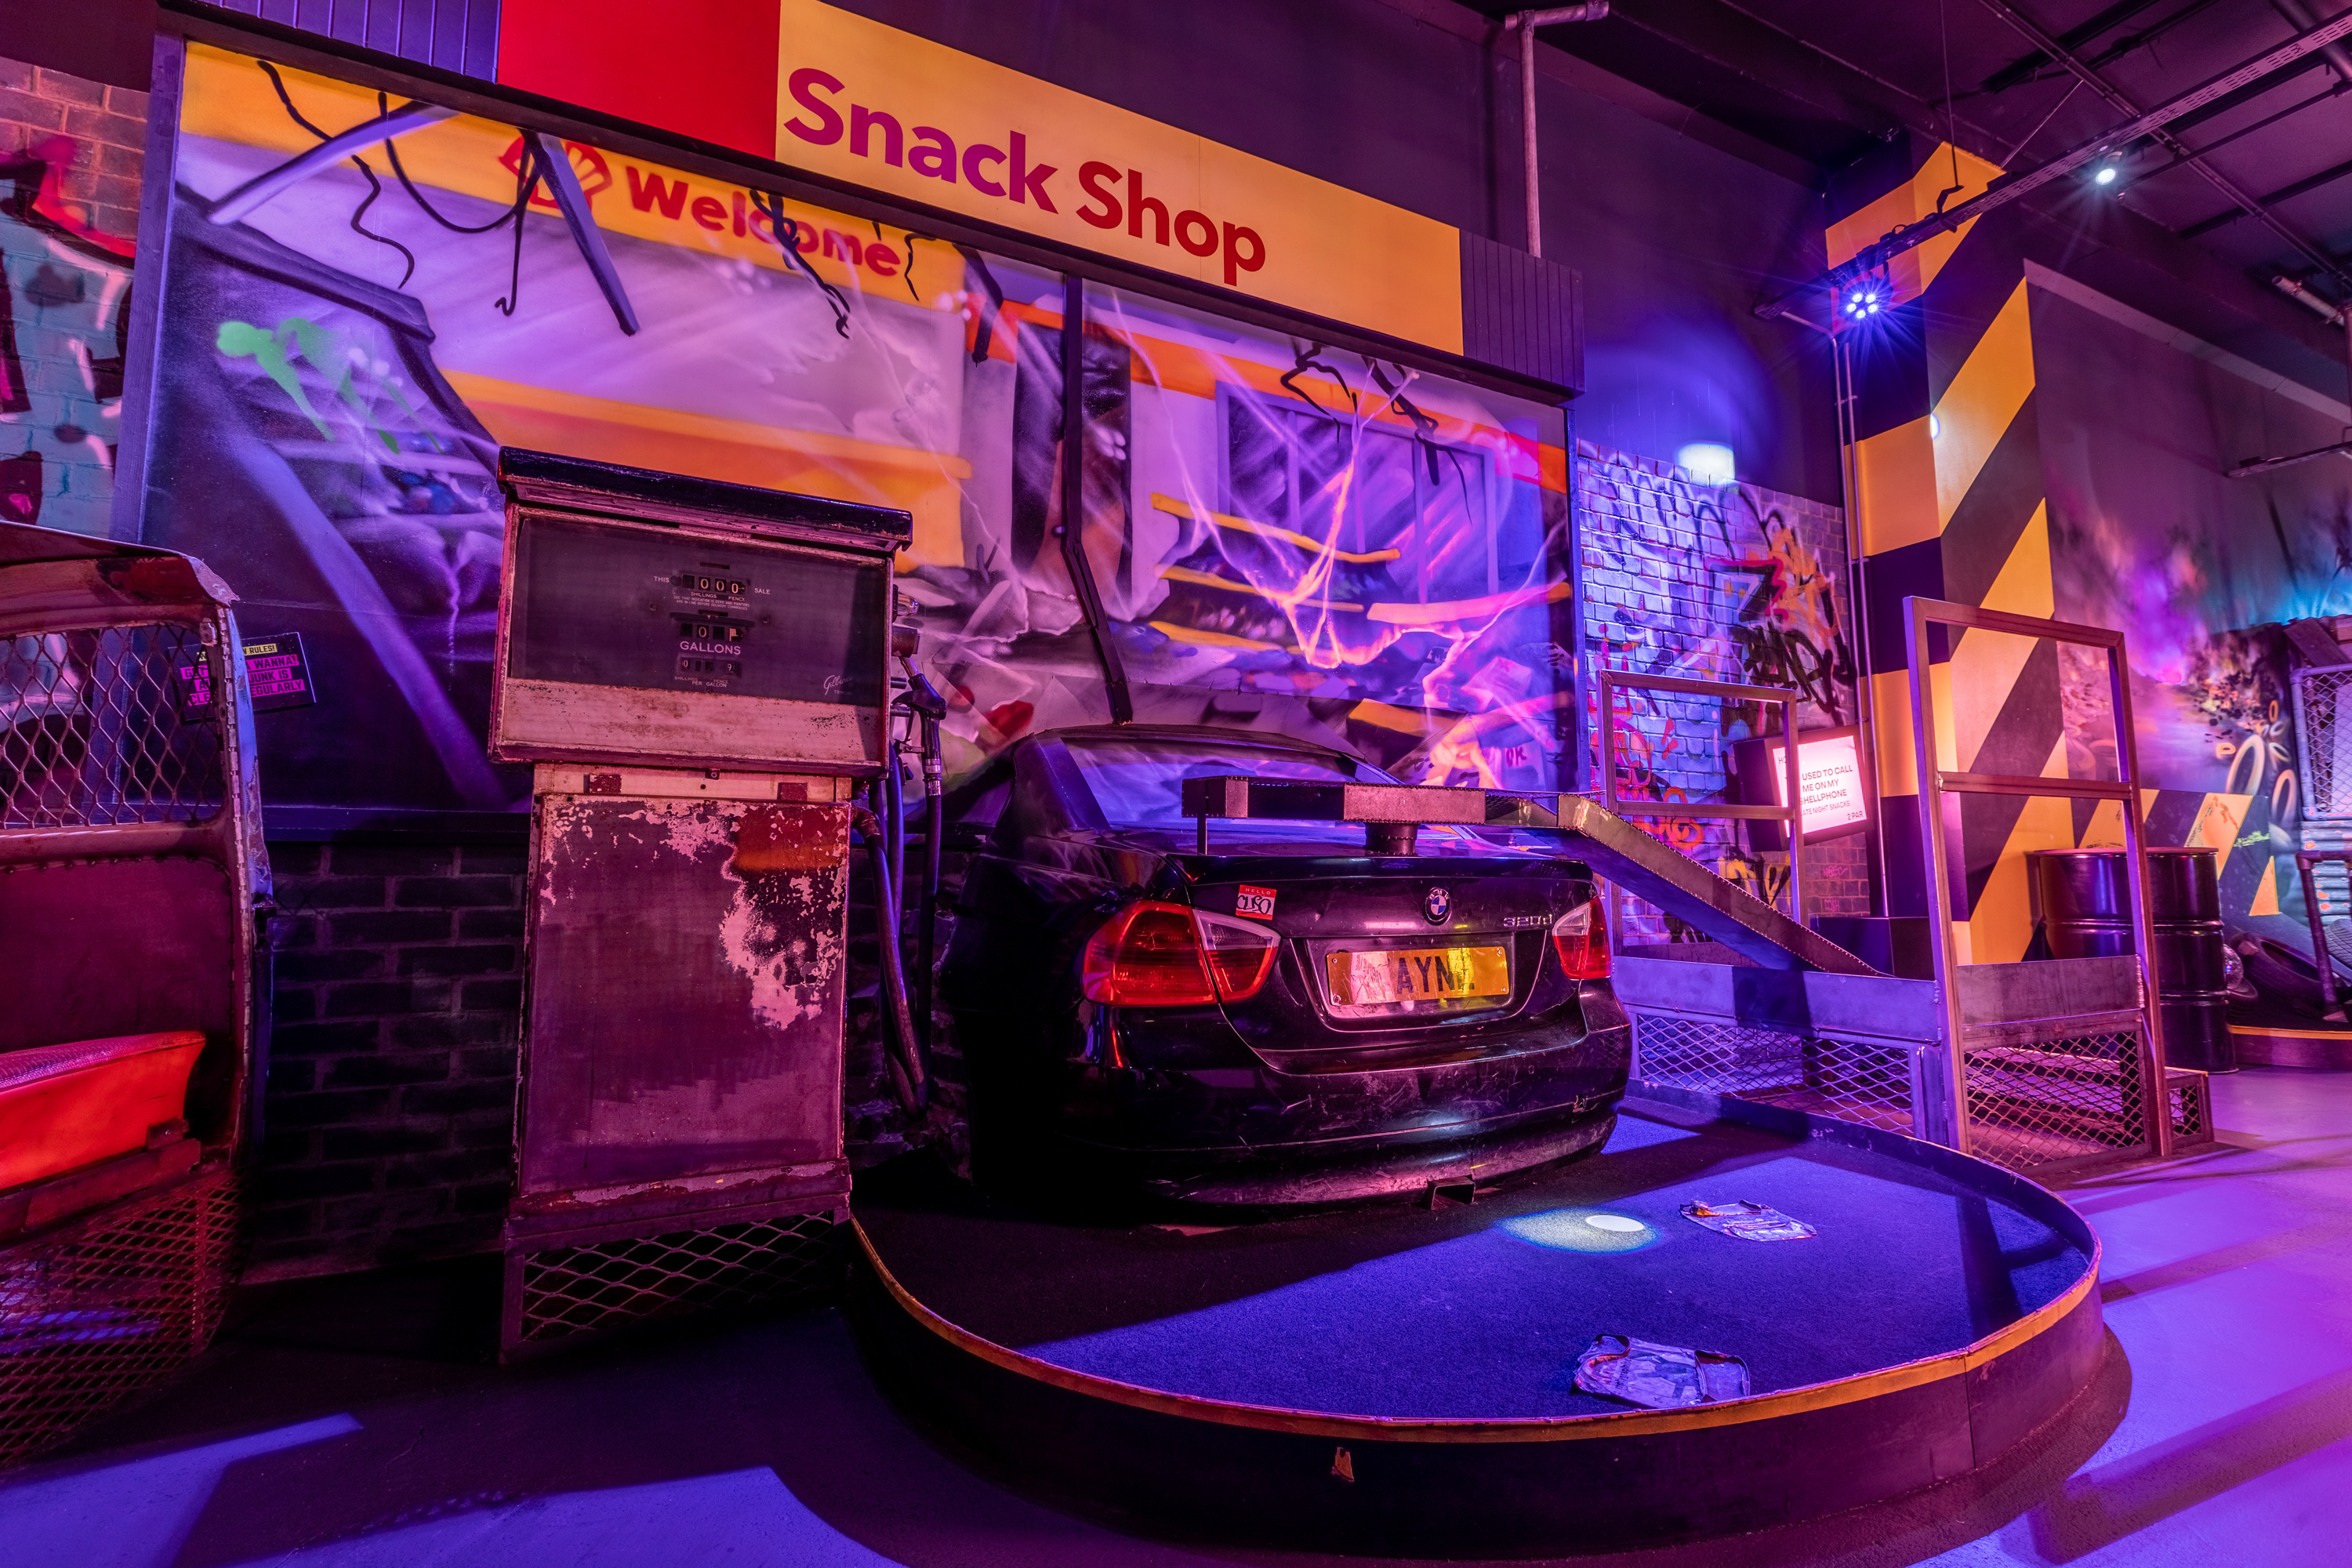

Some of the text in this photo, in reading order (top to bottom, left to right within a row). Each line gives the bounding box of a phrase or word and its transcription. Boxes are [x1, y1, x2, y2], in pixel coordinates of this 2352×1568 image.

[782, 67, 1266, 287] Snack Shop
[626, 166, 901, 277] Welcome
[249, 644, 275, 654] RULES!
[680, 641, 741, 655] GALLONS
[184, 666, 209, 678] GT
[254, 655, 296, 669] WANNA!
[249, 670, 289, 683] JUNK IS
[250, 681, 302, 696] EGULARLY
[1802, 764, 1853, 781] USED TO CALL
[1802, 779, 1839, 793] ME ON MY
[1802, 800, 1850, 817] ATE NIGHT SNACKS
[1852, 811, 1864, 819] PAR
[1503, 913, 1553, 927] 320d
